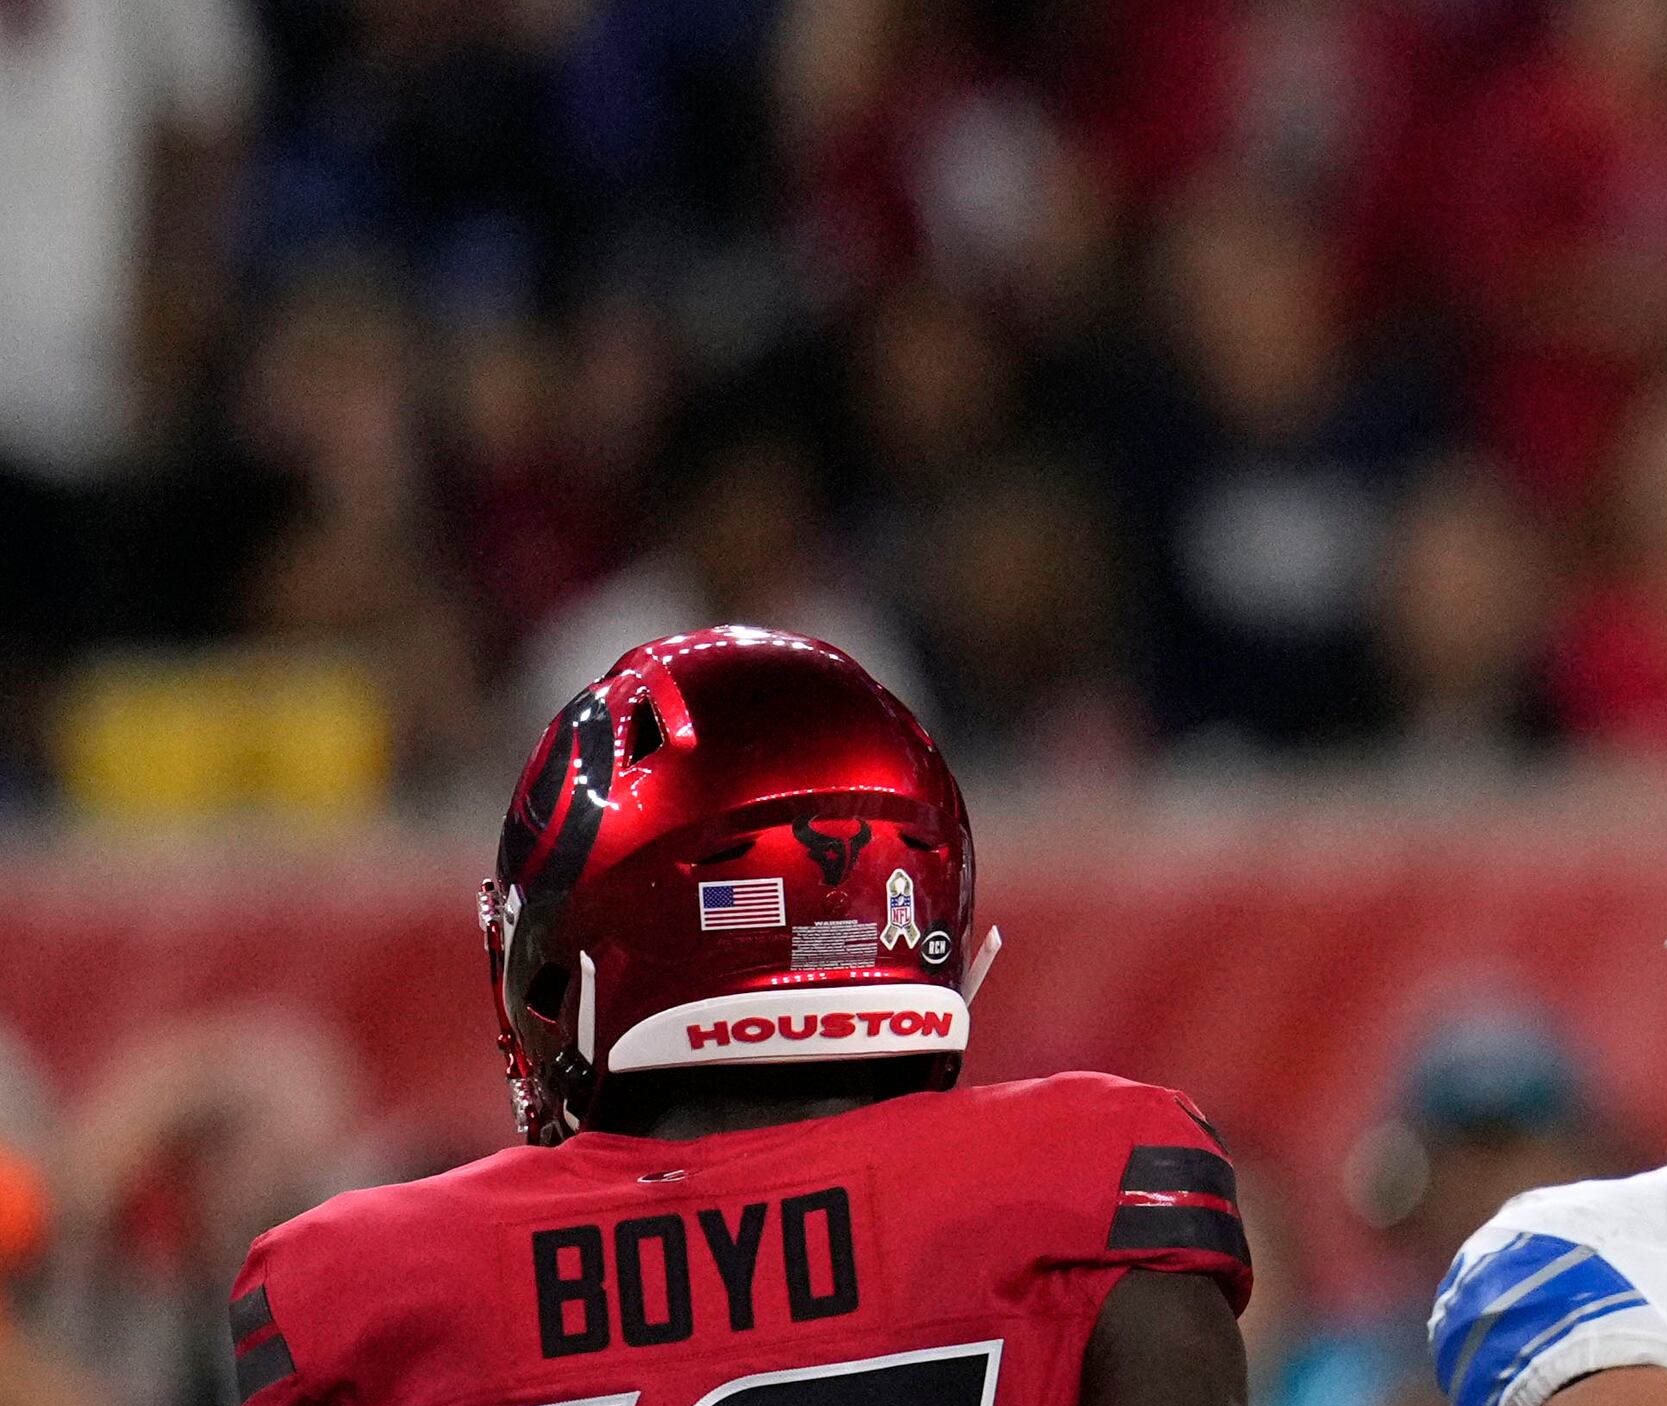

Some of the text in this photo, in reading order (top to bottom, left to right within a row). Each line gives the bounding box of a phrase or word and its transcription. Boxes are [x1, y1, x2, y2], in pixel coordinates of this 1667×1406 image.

[892, 907, 911, 925] NFL
[687, 1011, 953, 1051] HOUSTON
[532, 1186, 860, 1359] BOYD
